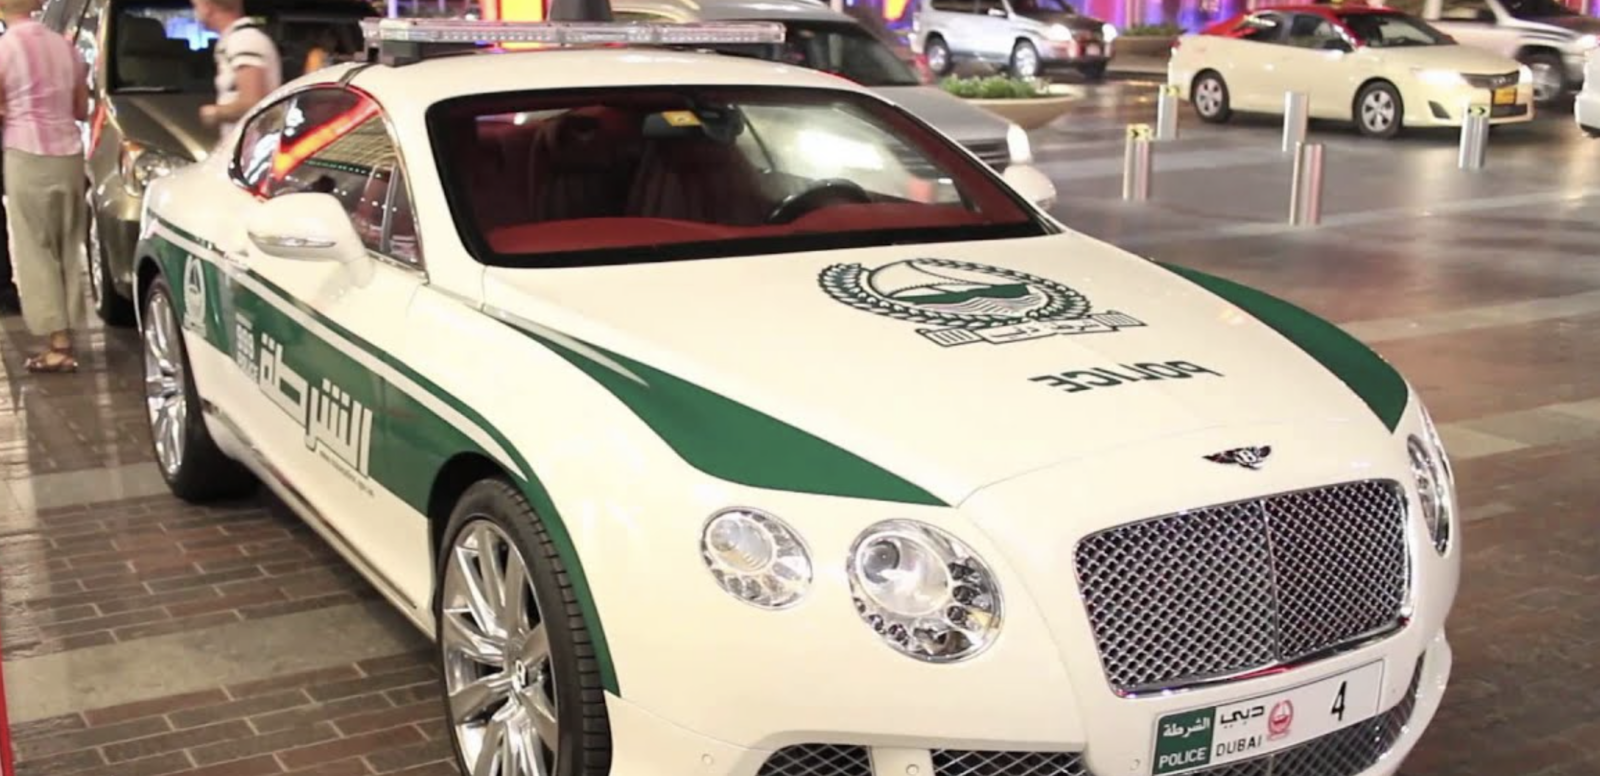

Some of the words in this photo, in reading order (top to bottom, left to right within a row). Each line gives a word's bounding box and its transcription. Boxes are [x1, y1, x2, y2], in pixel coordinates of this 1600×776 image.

[259, 332, 373, 479] الشرطة
[1331, 680, 1347, 721] 4
[1162, 716, 1211, 738] الشرطة
[1220, 705, 1265, 729] دبي
[1158, 746, 1208, 769] POLICE
[1216, 735, 1262, 757] DUBAI
